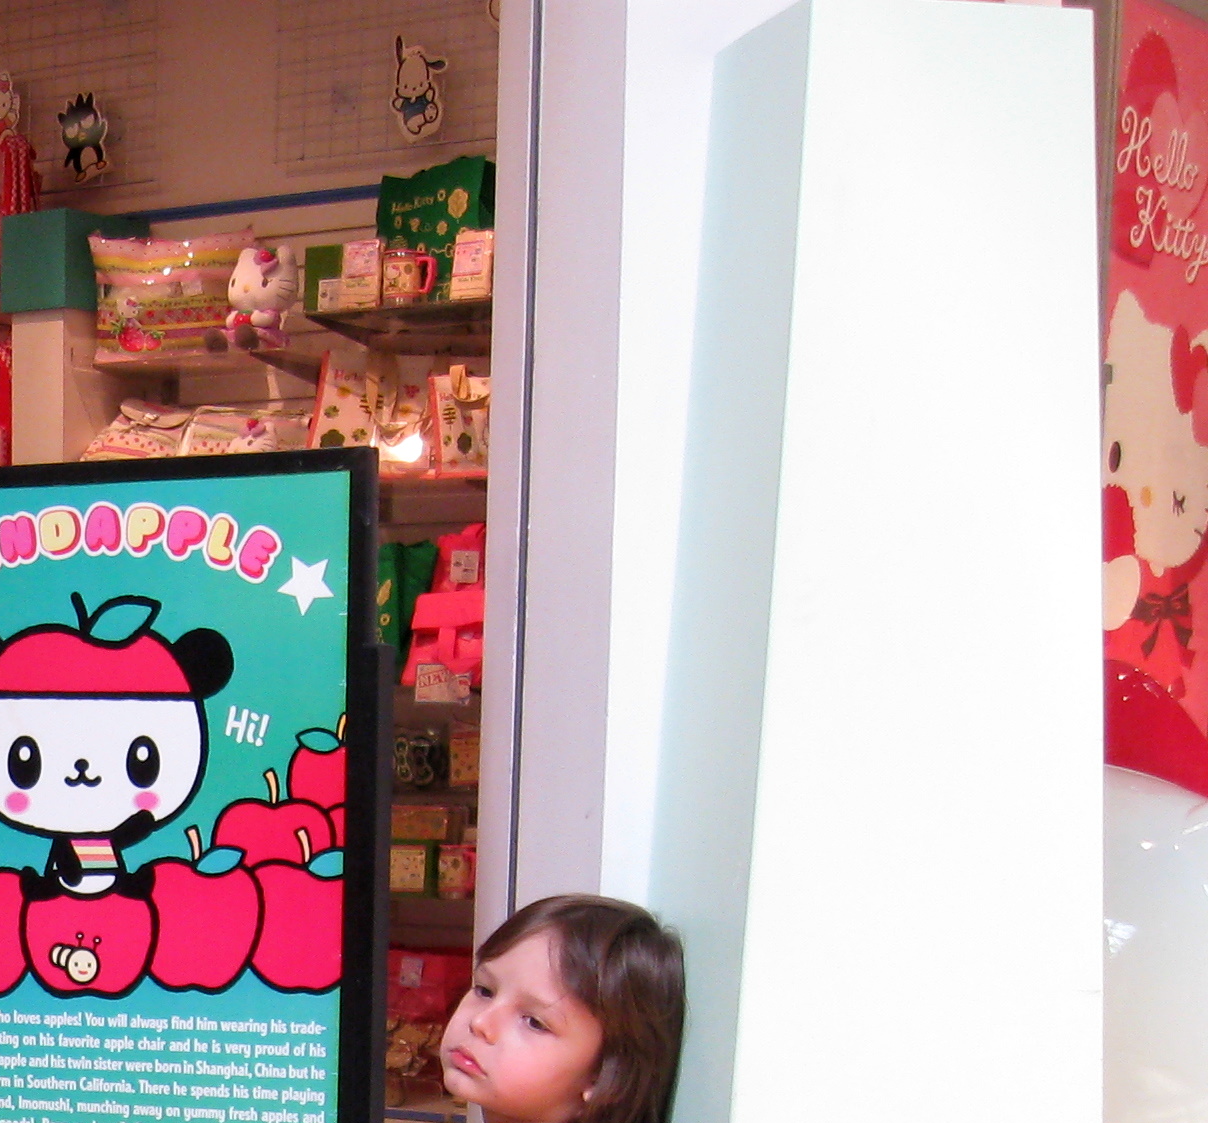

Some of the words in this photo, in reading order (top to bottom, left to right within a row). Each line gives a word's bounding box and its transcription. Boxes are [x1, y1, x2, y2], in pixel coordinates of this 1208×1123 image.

[1116, 105, 1198, 190] Hello
[1130, 186, 1208, 284] Kitty
[224, 705, 270, 748] Hi!
[13, 1010, 41, 1024] loves
[43, 1012, 82, 1028] apples!
[84, 1012, 105, 1026] You
[107, 1013, 128, 1027] will
[129, 1015, 168, 1033] always
[170, 1016, 194, 1030] find
[196, 1017, 218, 1031] him
[220, 1019, 268, 1036] wearing
[270, 1020, 287, 1033] his
[22, 1036, 36, 1046] on
[39, 1033, 55, 1047] his
[58, 1033, 100, 1048] favorite
[103, 1035, 134, 1052] apple
[137, 1037, 166, 1051] chair
[168, 1039, 190, 1052] and
[193, 1039, 208, 1053] he
[211, 1040, 221, 1054] is
[224, 1043, 251, 1058] very
[254, 1042, 290, 1058] proud
[293, 1043, 306, 1056] of
[309, 1043, 326, 1057] his
[13, 1075, 24, 1087] in
[26, 1075, 76, 1090] Southern
[79, 1077, 135, 1093] California.
[138, 1080, 170, 1095] There
[172, 1081, 187, 1096] he
[190, 1084, 230, 1099] spends
[232, 1084, 249, 1098] his
[252, 1086, 278, 1100] time
[281, 1088, 325, 1106] playing
